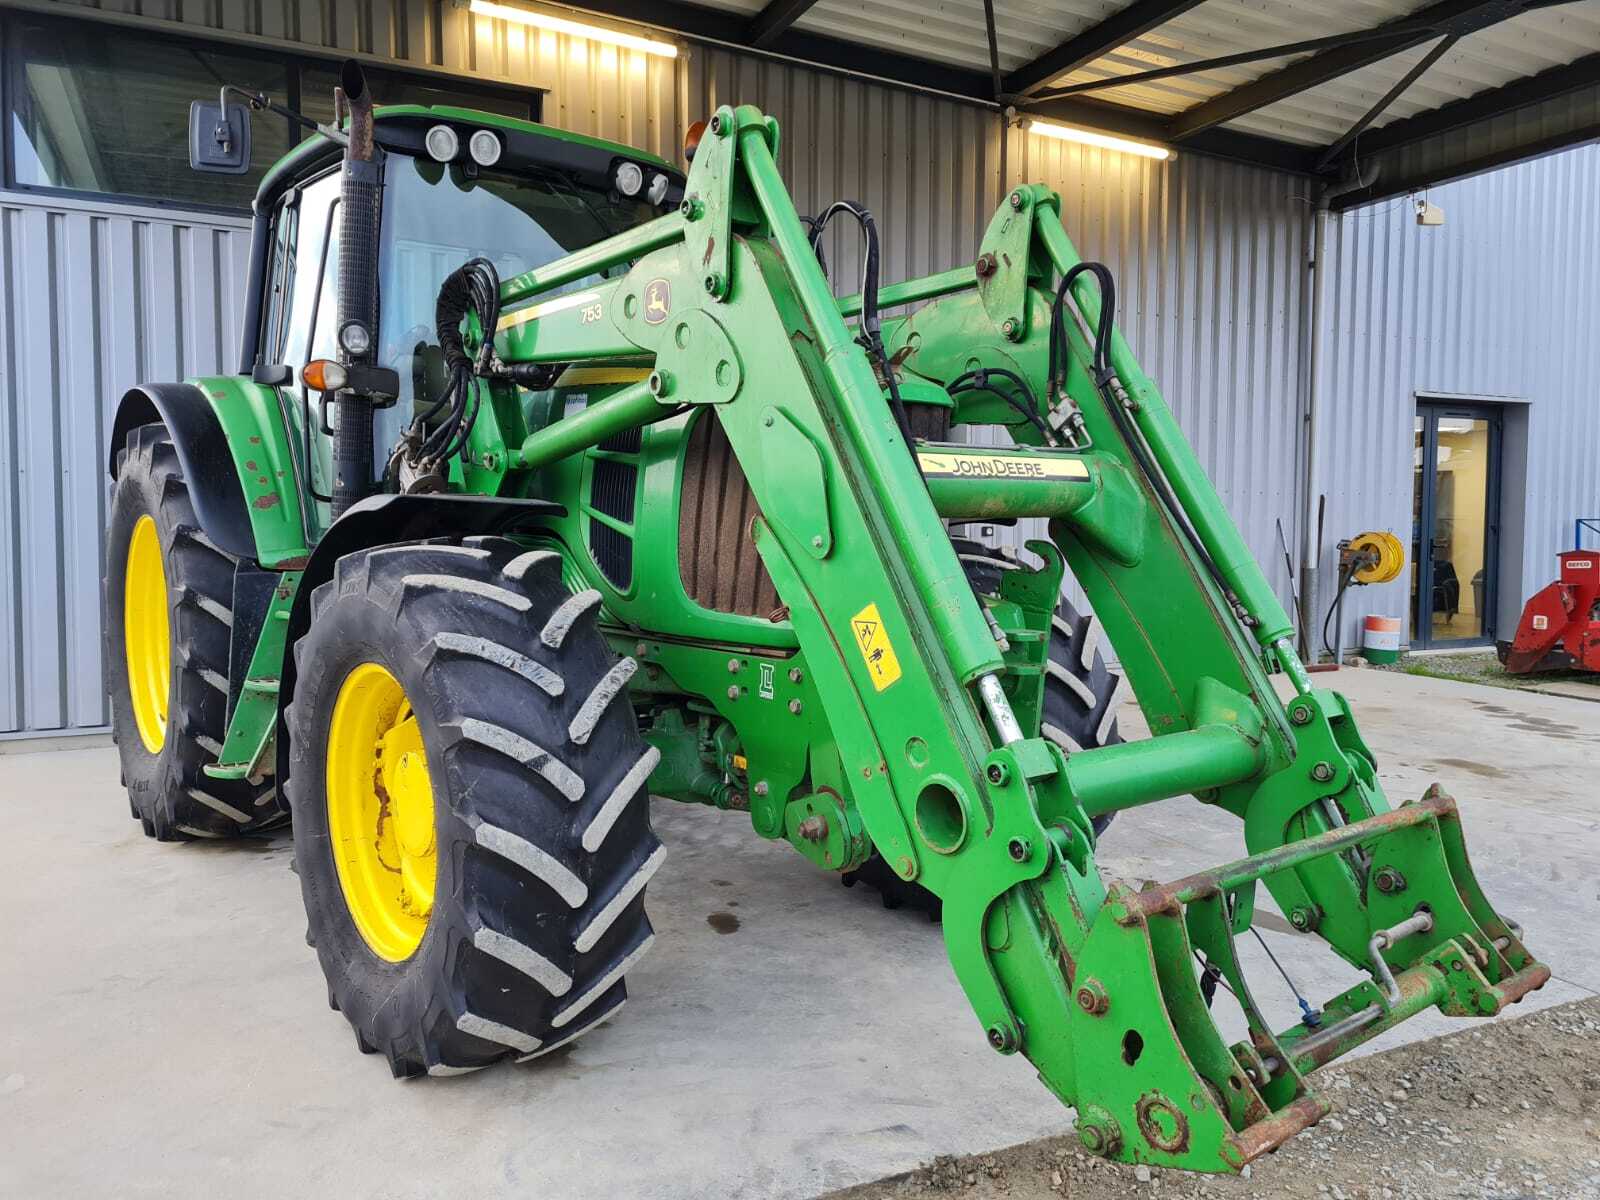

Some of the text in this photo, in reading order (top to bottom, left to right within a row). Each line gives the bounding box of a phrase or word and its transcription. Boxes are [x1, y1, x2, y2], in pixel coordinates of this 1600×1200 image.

[581, 303, 602, 324] 753
[952, 457, 1044, 476] JOHN DEERE
